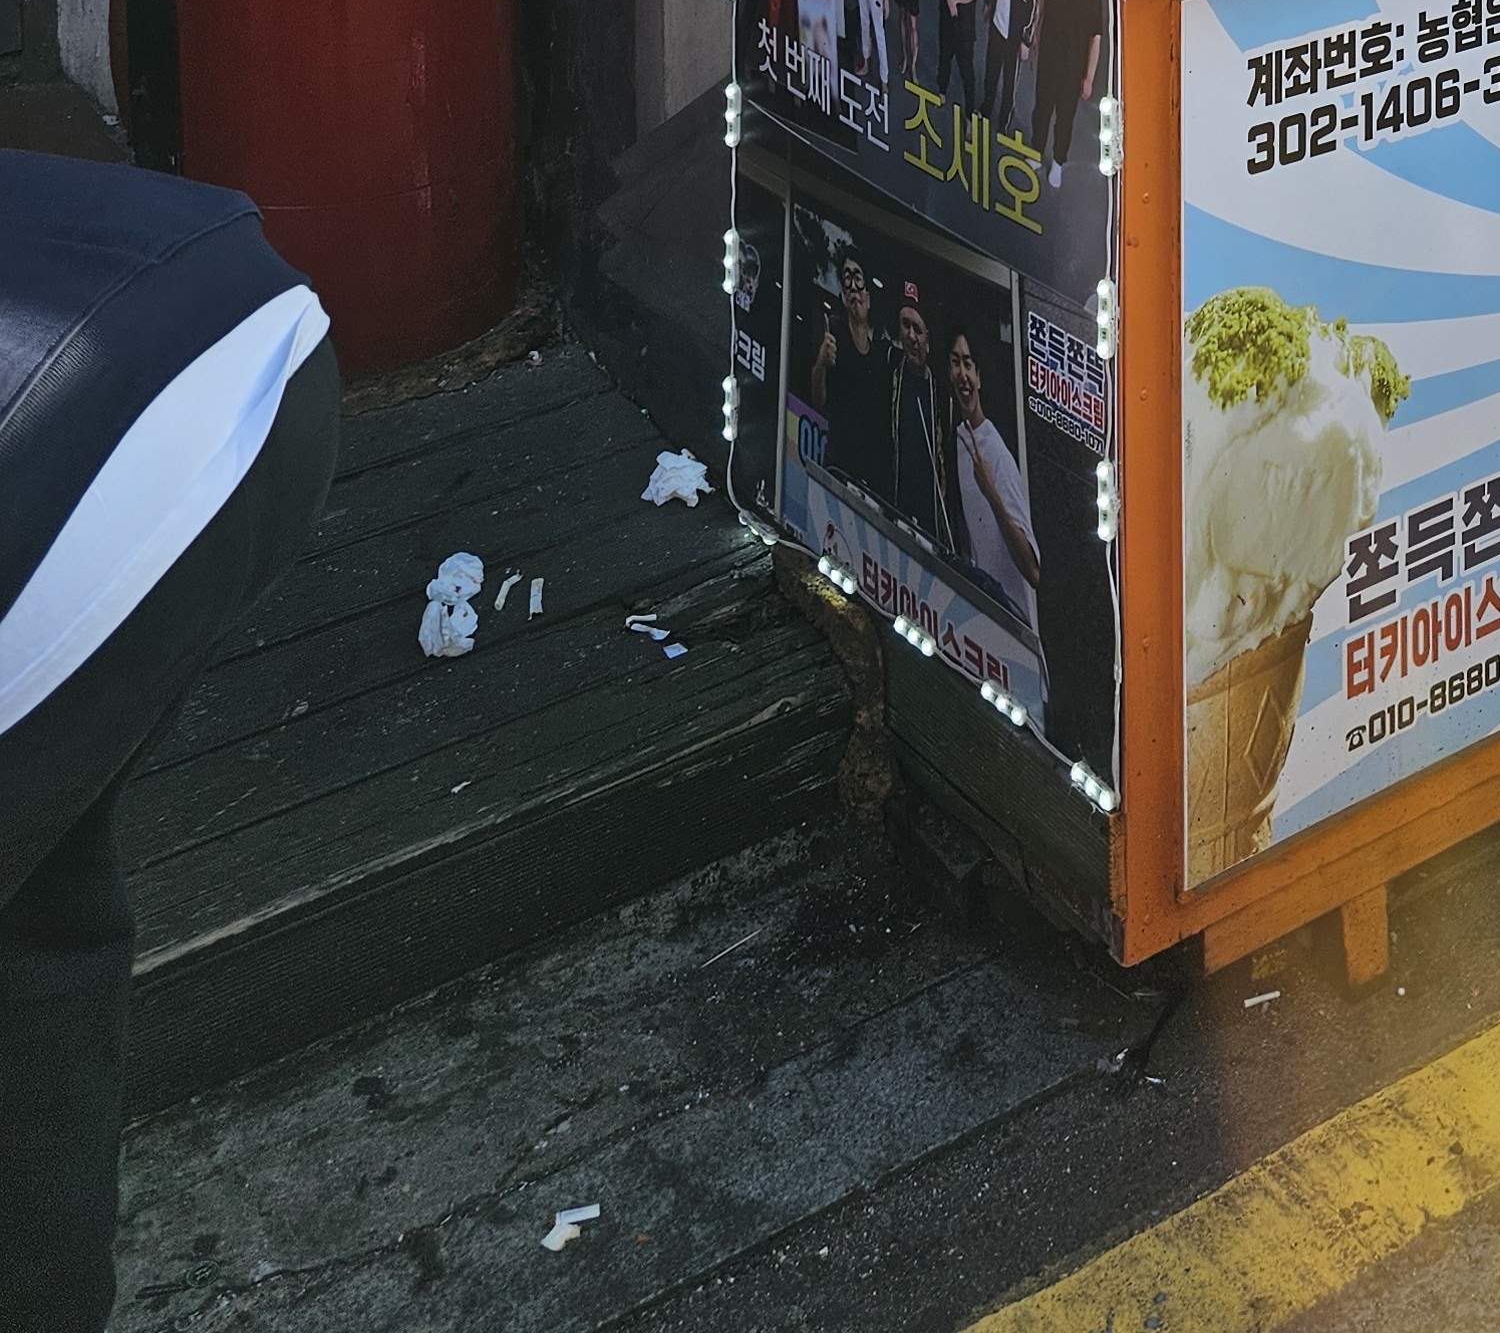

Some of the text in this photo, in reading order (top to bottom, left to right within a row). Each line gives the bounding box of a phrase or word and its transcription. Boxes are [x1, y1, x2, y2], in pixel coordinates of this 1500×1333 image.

[1246, 23, 1406, 110] 계좌번호:
[758, 17, 1043, 235] 첫 번째 도전 조세호
[734, 329, 766, 382] 크림
[1029, 359, 1104, 432] 터키아이스크림
